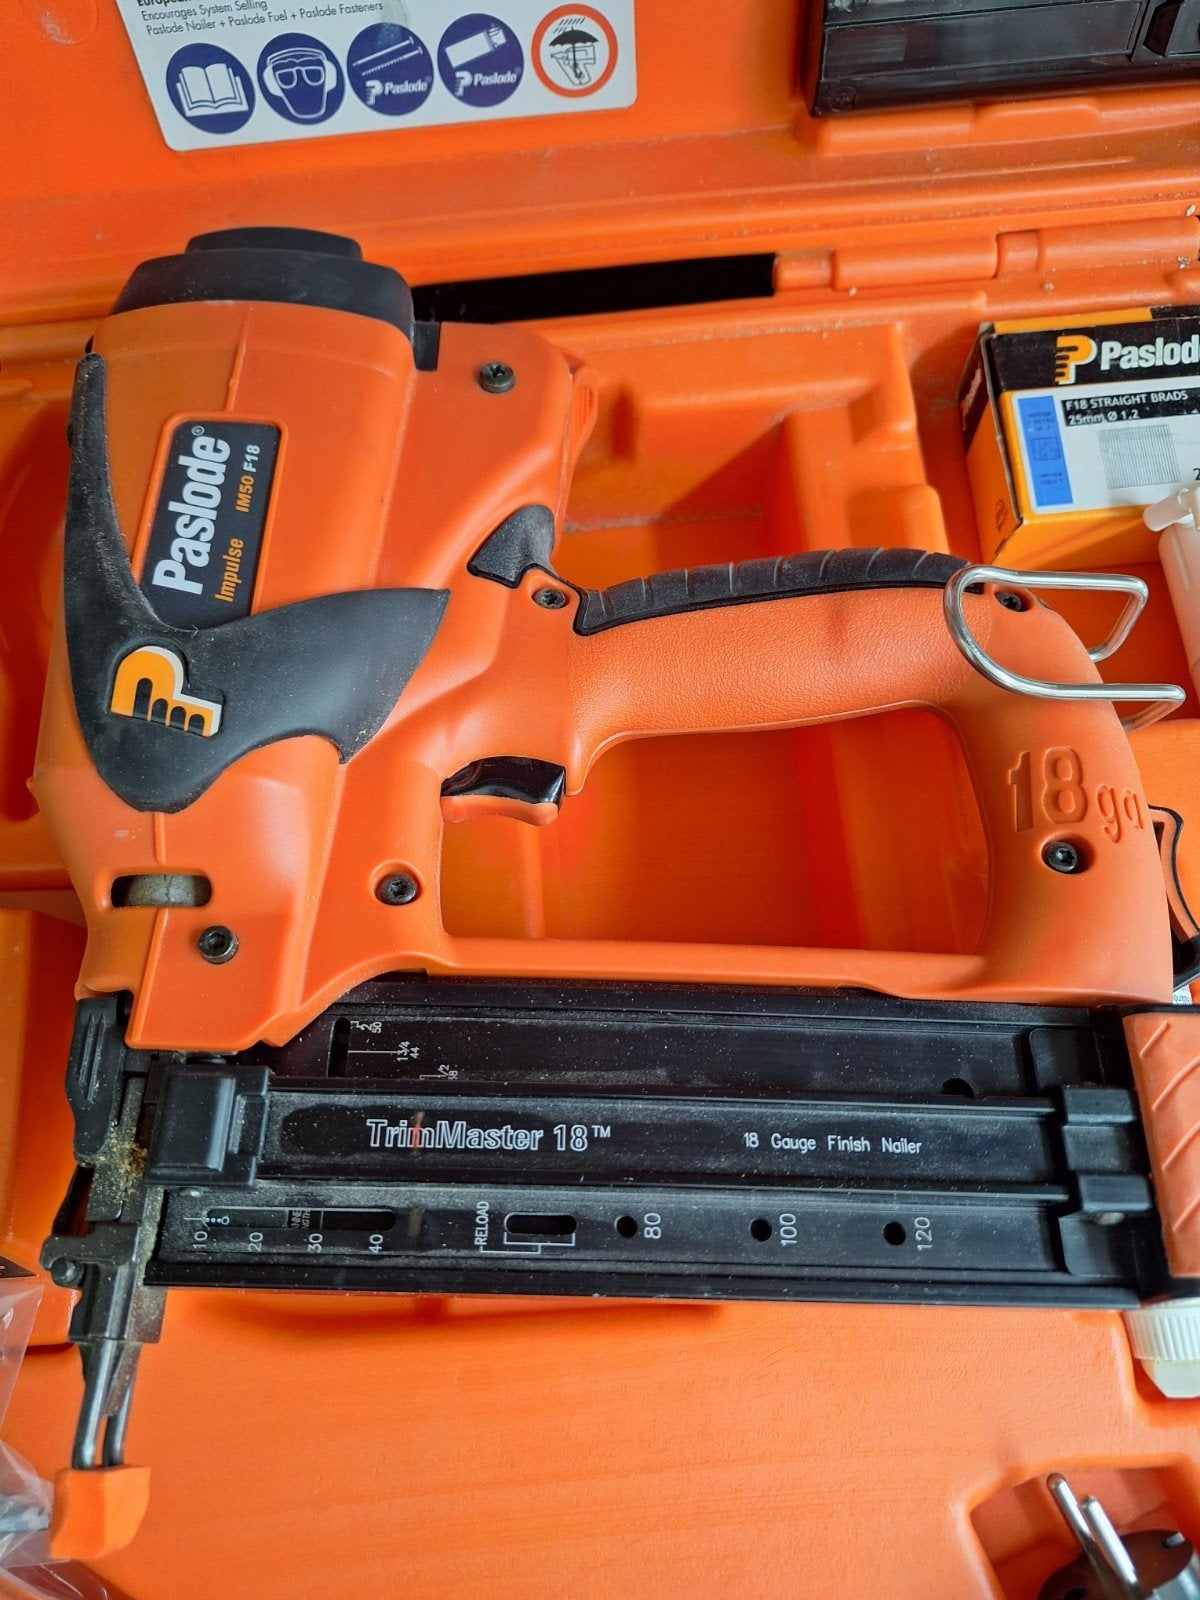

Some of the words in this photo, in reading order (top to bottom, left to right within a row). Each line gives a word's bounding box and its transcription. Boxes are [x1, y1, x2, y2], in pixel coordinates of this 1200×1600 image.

[141, 7, 198, 21] Encourages
[199, 3, 233, 17] System
[235, 0, 268, 12] Selling
[145, 22, 184, 36] Paslode
[185, 18, 216, 32] Nailer
[227, 13, 266, 27] Paslode
[267, 9, 288, 22] Fuel
[299, 6, 338, 19] Paslode
[339, 2, 384, 15] Fasteners
[1100, 334, 1200, 371] Paslod
[1065, 400, 1089, 412] F18
[1089, 394, 1147, 408] STRAIGHT
[1150, 390, 1189, 403] BRADS
[1066, 413, 1105, 426] 25mm
[243, 443, 262, 473] F18
[235, 474, 256, 514] IM50
[214, 537, 245, 603] Impulse
[372, 1021, 383, 1034] 50
[409, 1046, 420, 1059] 44
[366, 1119, 543, 1151] TrimMaster
[743, 1132, 759, 1149] 18
[770, 1133, 817, 1154] Gauge
[827, 1134, 871, 1152] Finish
[881, 1137, 922, 1154] Nailer
[474, 1200, 489, 1246] RELOAD
[643, 1212, 662, 1240] 80
[779, 1213, 798, 1247] 100
[914, 1217, 933, 1251] 120
[193, 1231, 208, 1249] 10
[247, 1232, 263, 1252] 20
[307, 1233, 323, 1253] 30
[368, 1234, 384, 1254] 40
